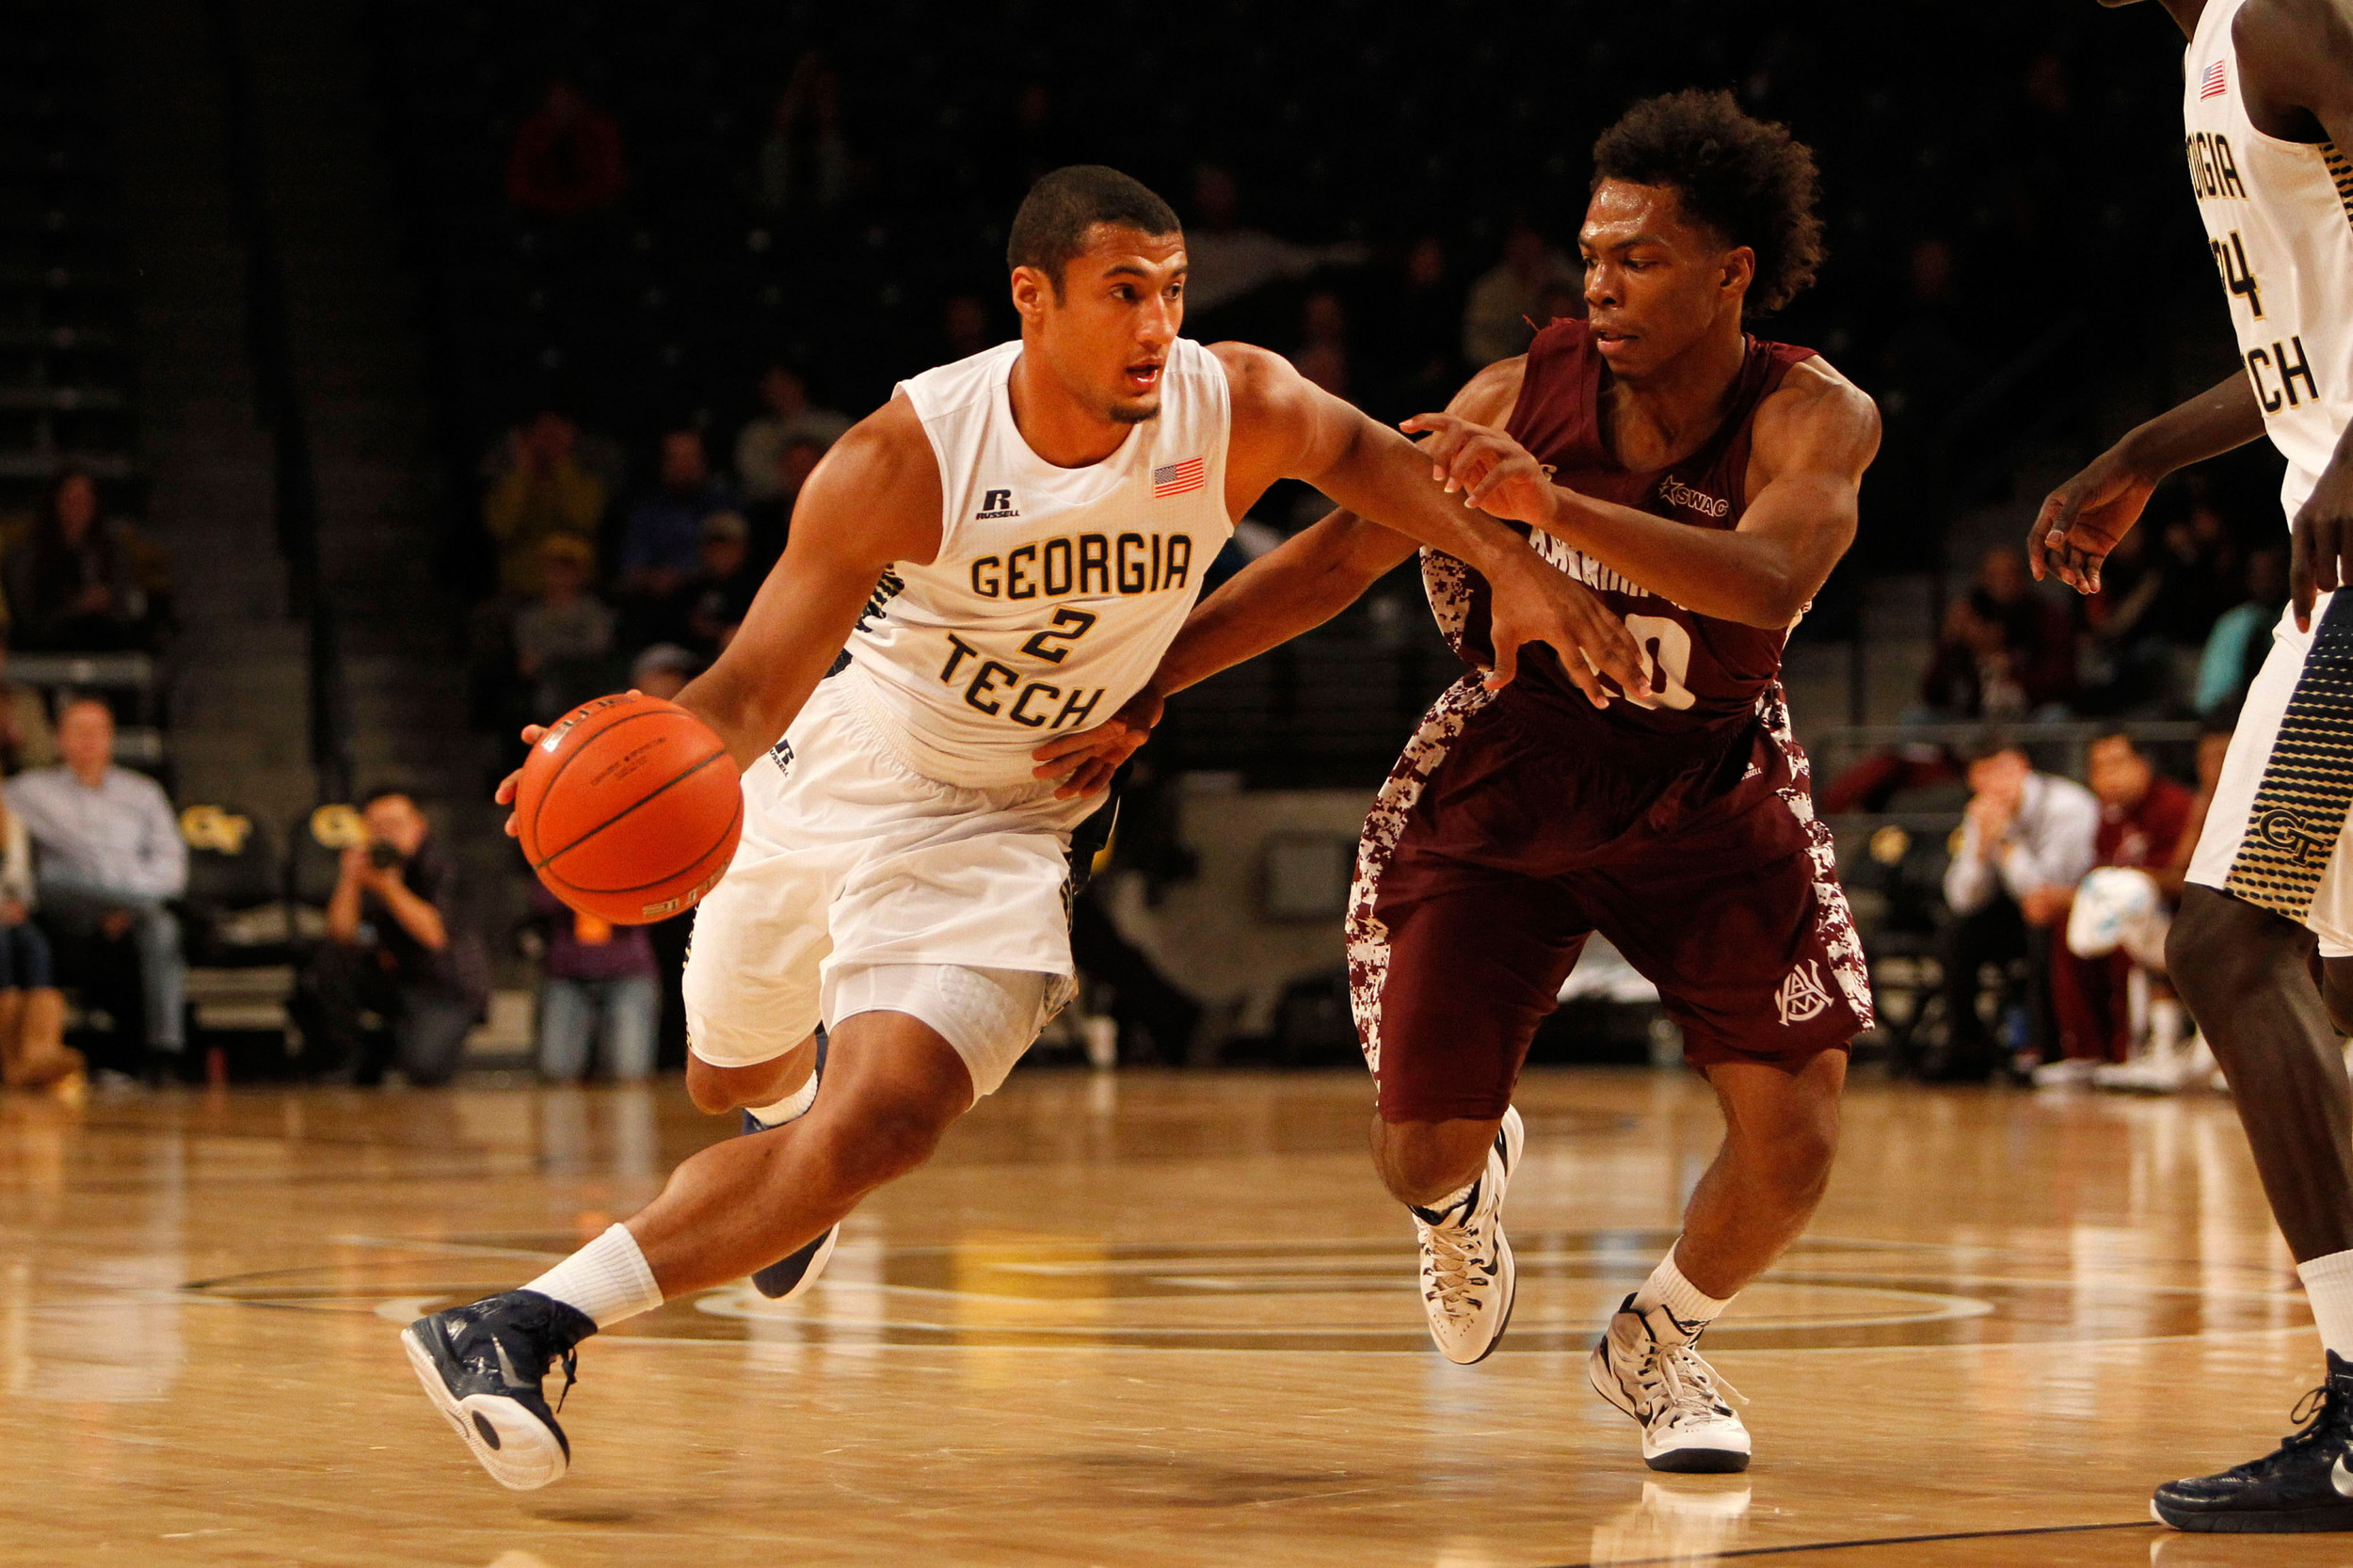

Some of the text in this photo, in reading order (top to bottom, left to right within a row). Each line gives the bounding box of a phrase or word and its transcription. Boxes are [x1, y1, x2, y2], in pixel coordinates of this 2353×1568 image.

[2186, 132, 2248, 200] ORGIA
[2242, 335, 2320, 414] CH
[975, 508, 1020, 520] RUSSELL
[1675, 487, 1730, 518] SWAC
[970, 532, 1193, 601] GEORGIA
[1019, 606, 1098, 665] 2
[939, 632, 1108, 730] TECH
[769, 747, 790, 778] USSELL
[1740, 766, 1763, 782] SSELL
